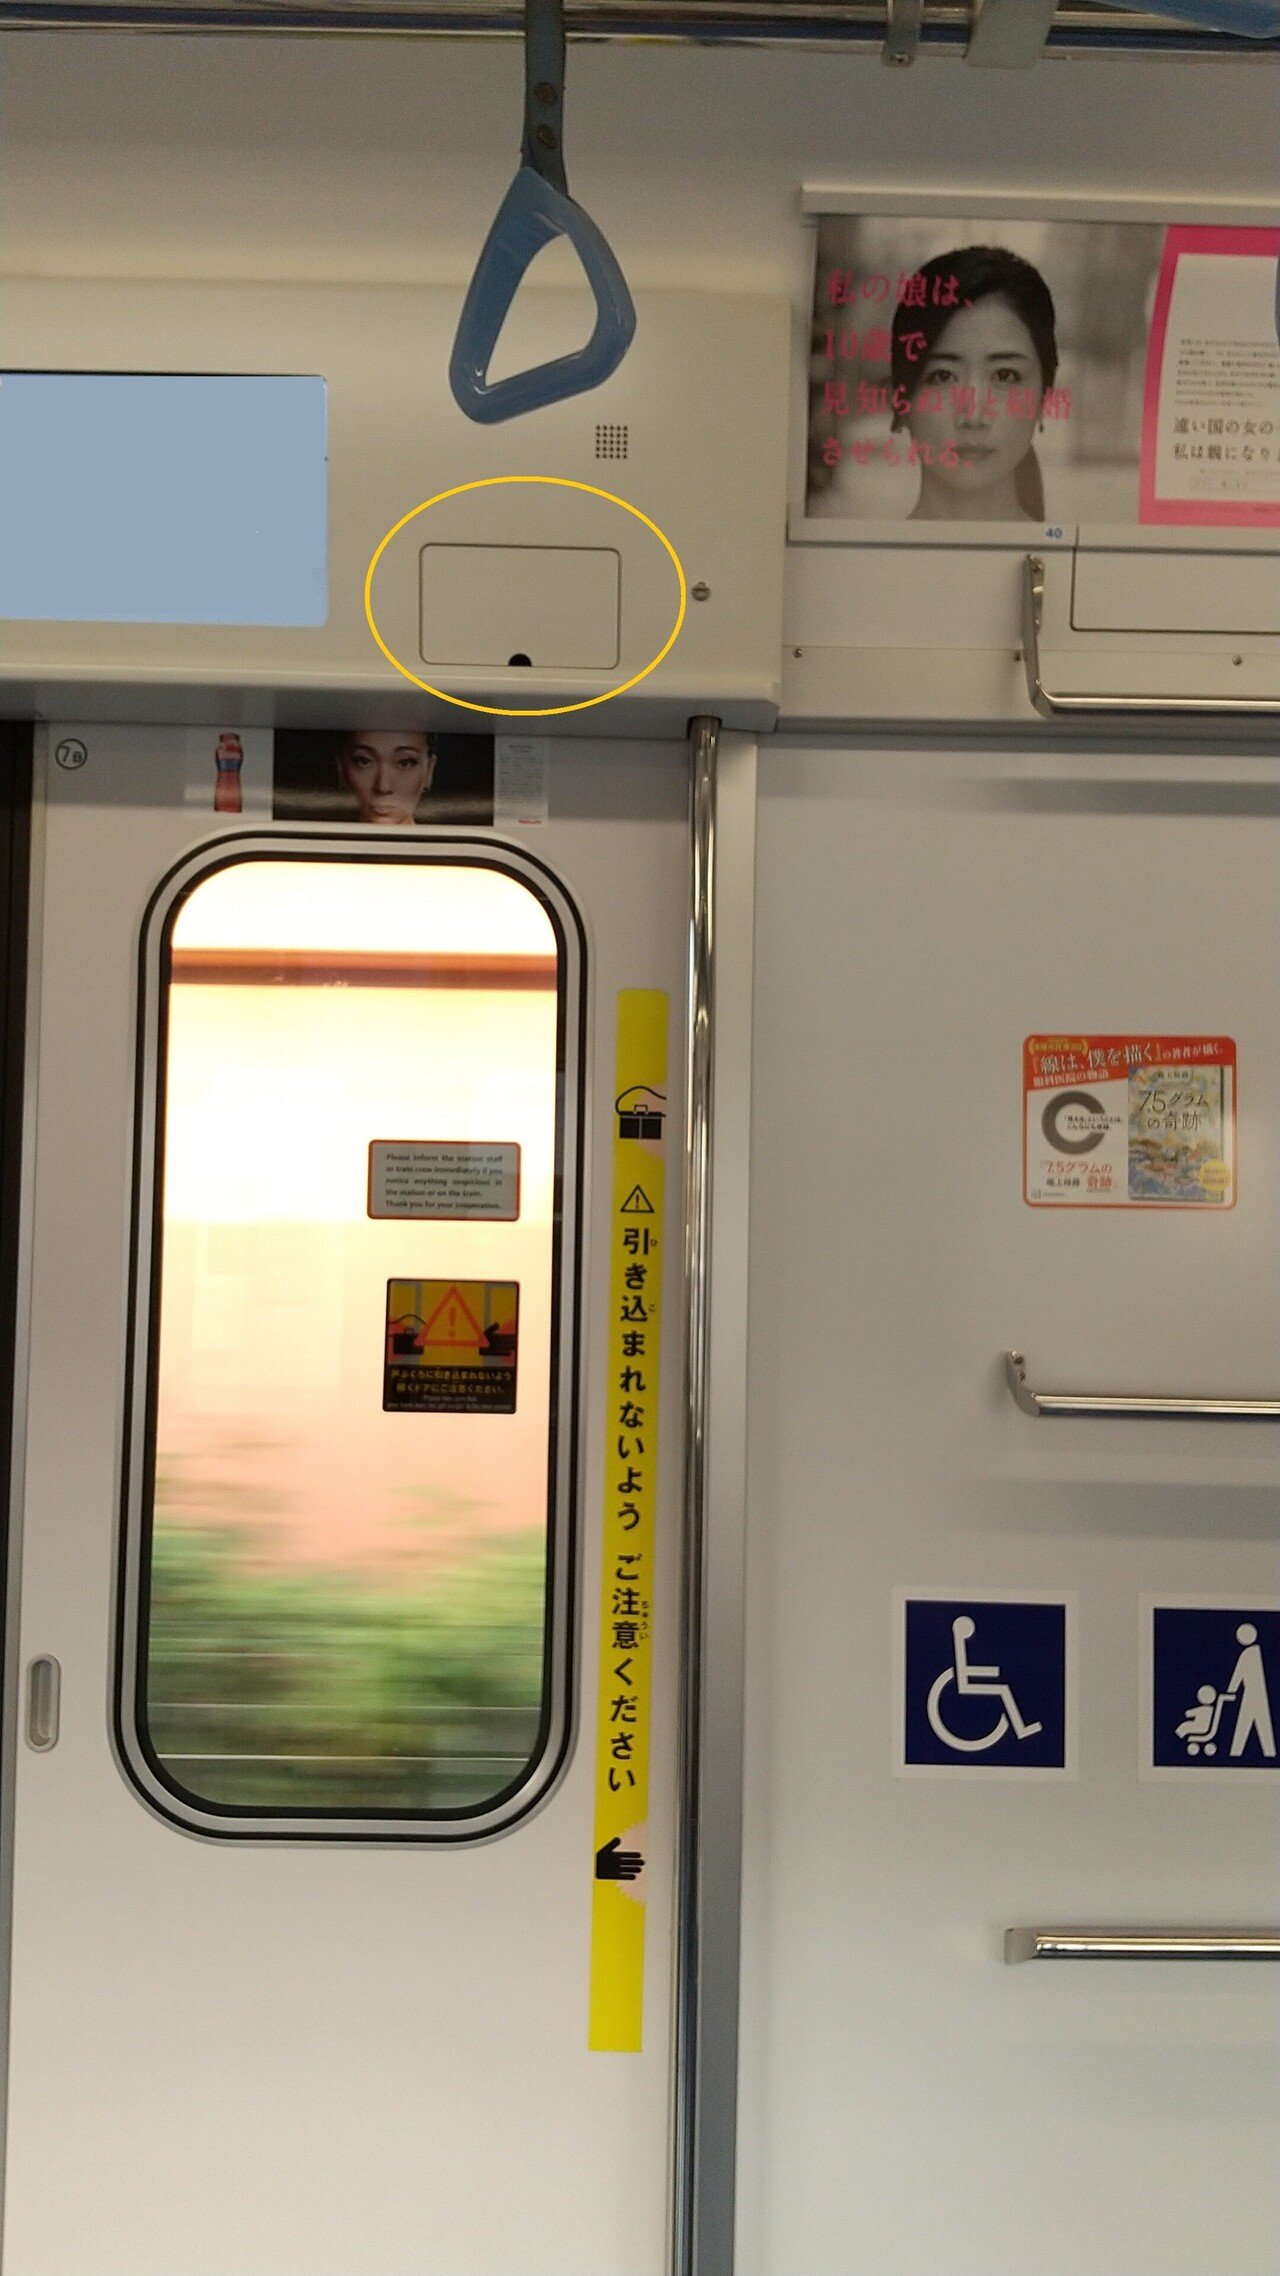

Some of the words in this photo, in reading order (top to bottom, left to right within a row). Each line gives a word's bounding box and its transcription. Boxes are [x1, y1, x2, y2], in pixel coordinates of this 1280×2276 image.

[827, 269, 974, 309] 私の娘は、
[823, 328, 928, 362] 10歳で
[821, 381, 1073, 420] 見知らぬ男と結婚
[822, 437, 975, 470] させられる。
[1174, 443, 1280, 462] 私は親になり
[387, 1153, 410, 1162] Please
[441, 1154, 454, 1162] the
[385, 1188, 398, 1196] the
[449, 1189, 460, 1197] the
[414, 1178, 448, 1187] anything
[386, 1200, 408, 1208] Thank
[409, 1201, 424, 1210] you
[425, 1200, 435, 1208] for
[437, 1202, 454, 1210] your
[617, 1227, 650, 1532] 引き込まれないよう
[608, 1553, 643, 1793] ご注意ください
